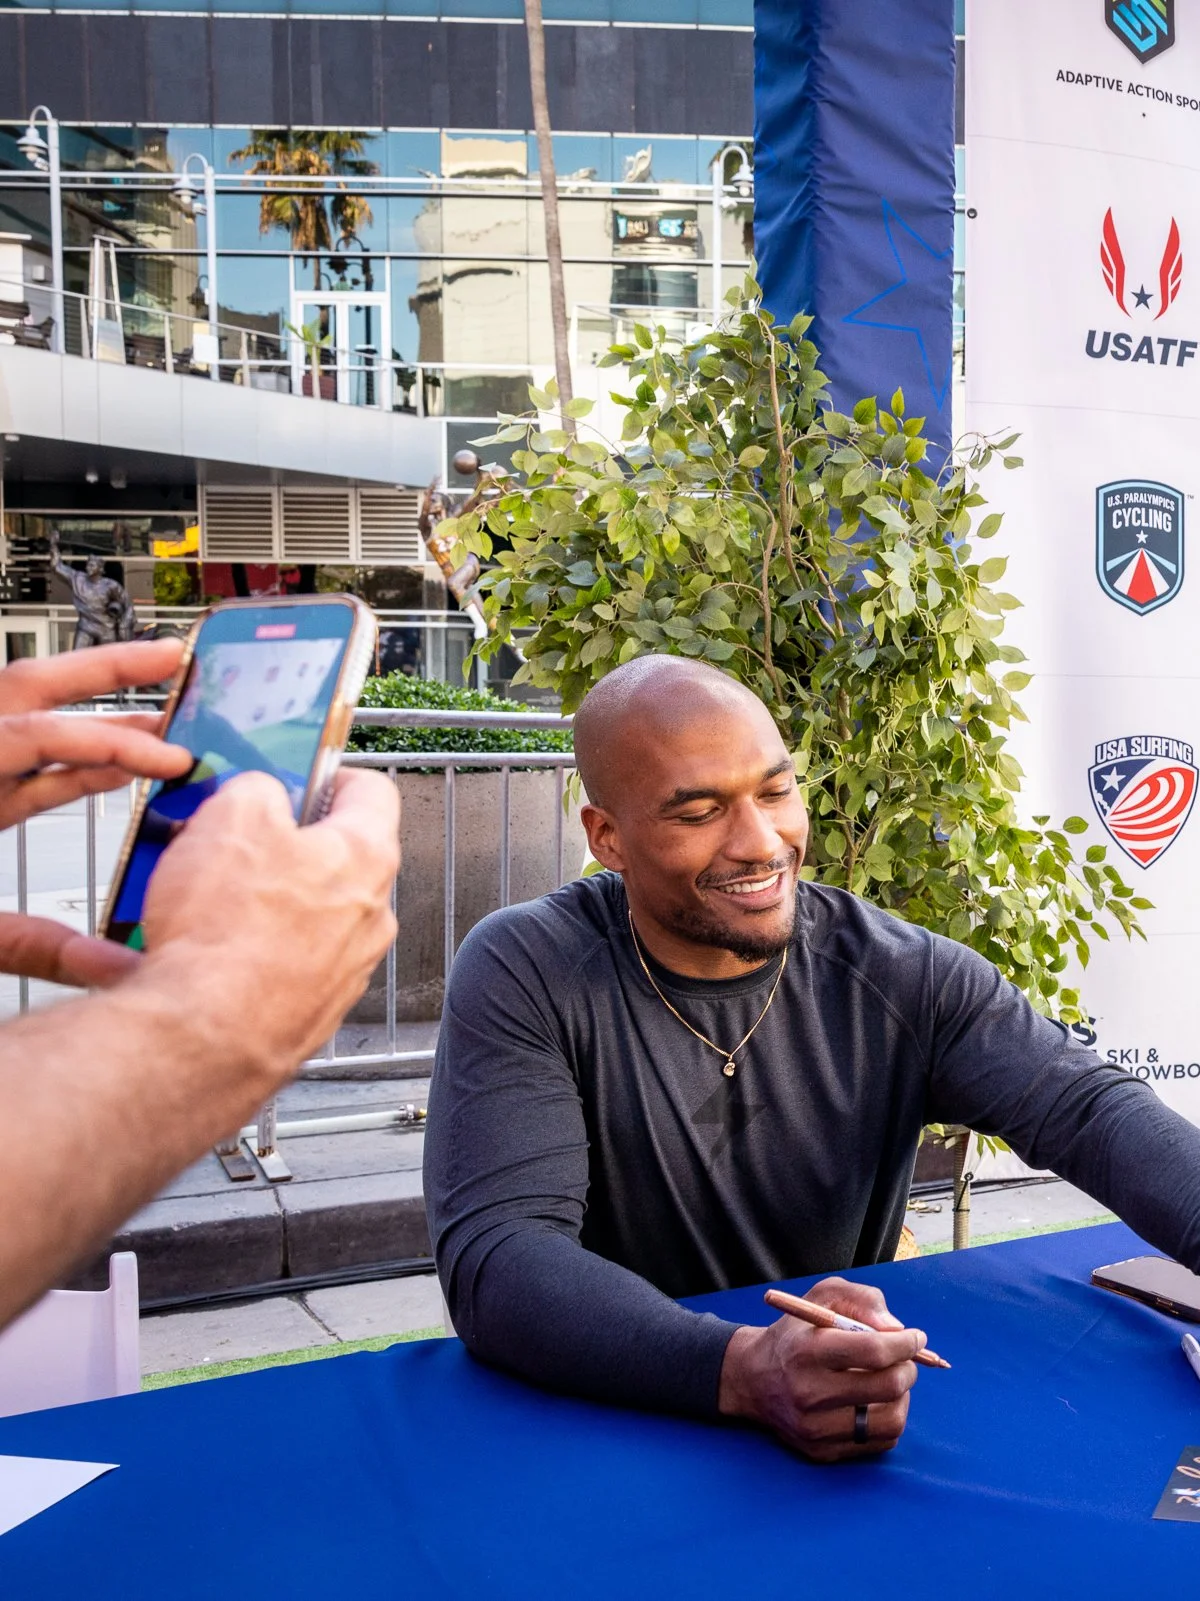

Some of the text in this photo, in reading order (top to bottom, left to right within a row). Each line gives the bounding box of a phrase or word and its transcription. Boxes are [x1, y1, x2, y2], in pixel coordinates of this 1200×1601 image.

[1056, 69, 1123, 93] ADAPTIVE
[1127, 82, 1173, 105] ACTION
[1085, 329, 1198, 367] USATF
[1107, 492, 1175, 512] U.S. PARALYMPICS
[1112, 507, 1172, 533] CYCLING
[1096, 736, 1193, 764] USA SURFING
[1106, 1048, 1159, 1064] SKI &
